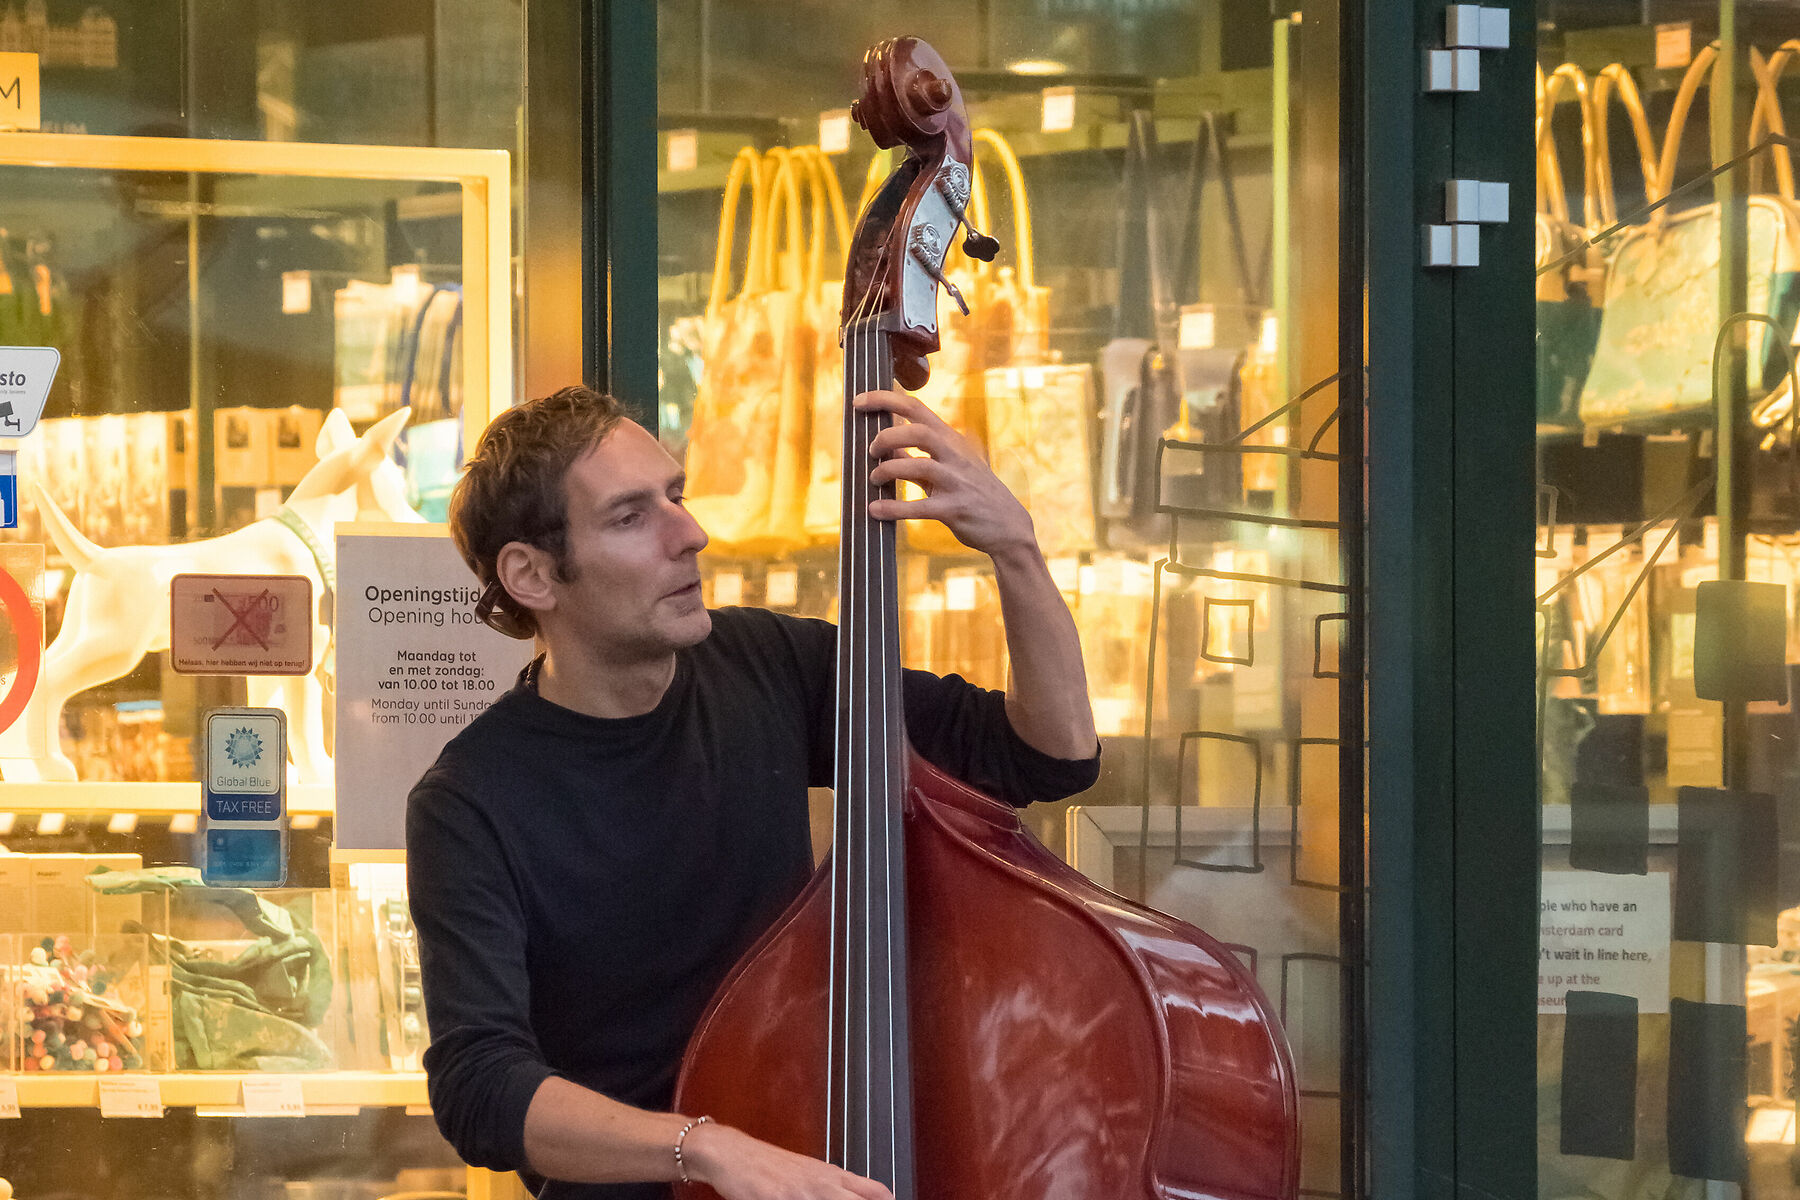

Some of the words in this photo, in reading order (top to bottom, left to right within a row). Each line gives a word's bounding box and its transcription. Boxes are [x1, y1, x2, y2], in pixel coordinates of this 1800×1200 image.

[365, 585, 481, 605] Openingstijd
[368, 607, 445, 627] Opening
[451, 608, 484, 625] hou
[397, 650, 455, 663] Maandag
[459, 651, 477, 662] tot
[248, 659, 259, 669] wij
[260, 659, 273, 668] niet
[274, 661, 284, 669] op
[389, 667, 404, 676] en
[408, 665, 431, 676] met
[435, 665, 485, 679] zondag:
[378, 681, 400, 690] van
[404, 679, 438, 690] 10.00
[441, 680, 459, 691] tot
[463, 679, 495, 691] 18.00
[371, 698, 420, 711] Monday
[424, 699, 450, 710] until
[454, 699, 492, 711] Sunda
[372, 713, 400, 724] from
[404, 713, 436, 724] 10.00
[440, 713, 466, 725] until
[217, 775, 248, 787] Global
[250, 776, 271, 787] Blue
[216, 800, 239, 814] TAX
[242, 801, 272, 814] FREE
[1561, 900, 1587, 912] who
[1590, 899, 1619, 912] have
[1623, 902, 1637, 912] an
[1598, 924, 1624, 937] card
[1554, 948, 1581, 961] wait
[1584, 948, 1594, 960] in
[1598, 949, 1619, 961] line
[1622, 949, 1652, 963] here,
[1548, 976, 1563, 987] up
[1566, 974, 1578, 985] at
[1581, 974, 1600, 985] the
